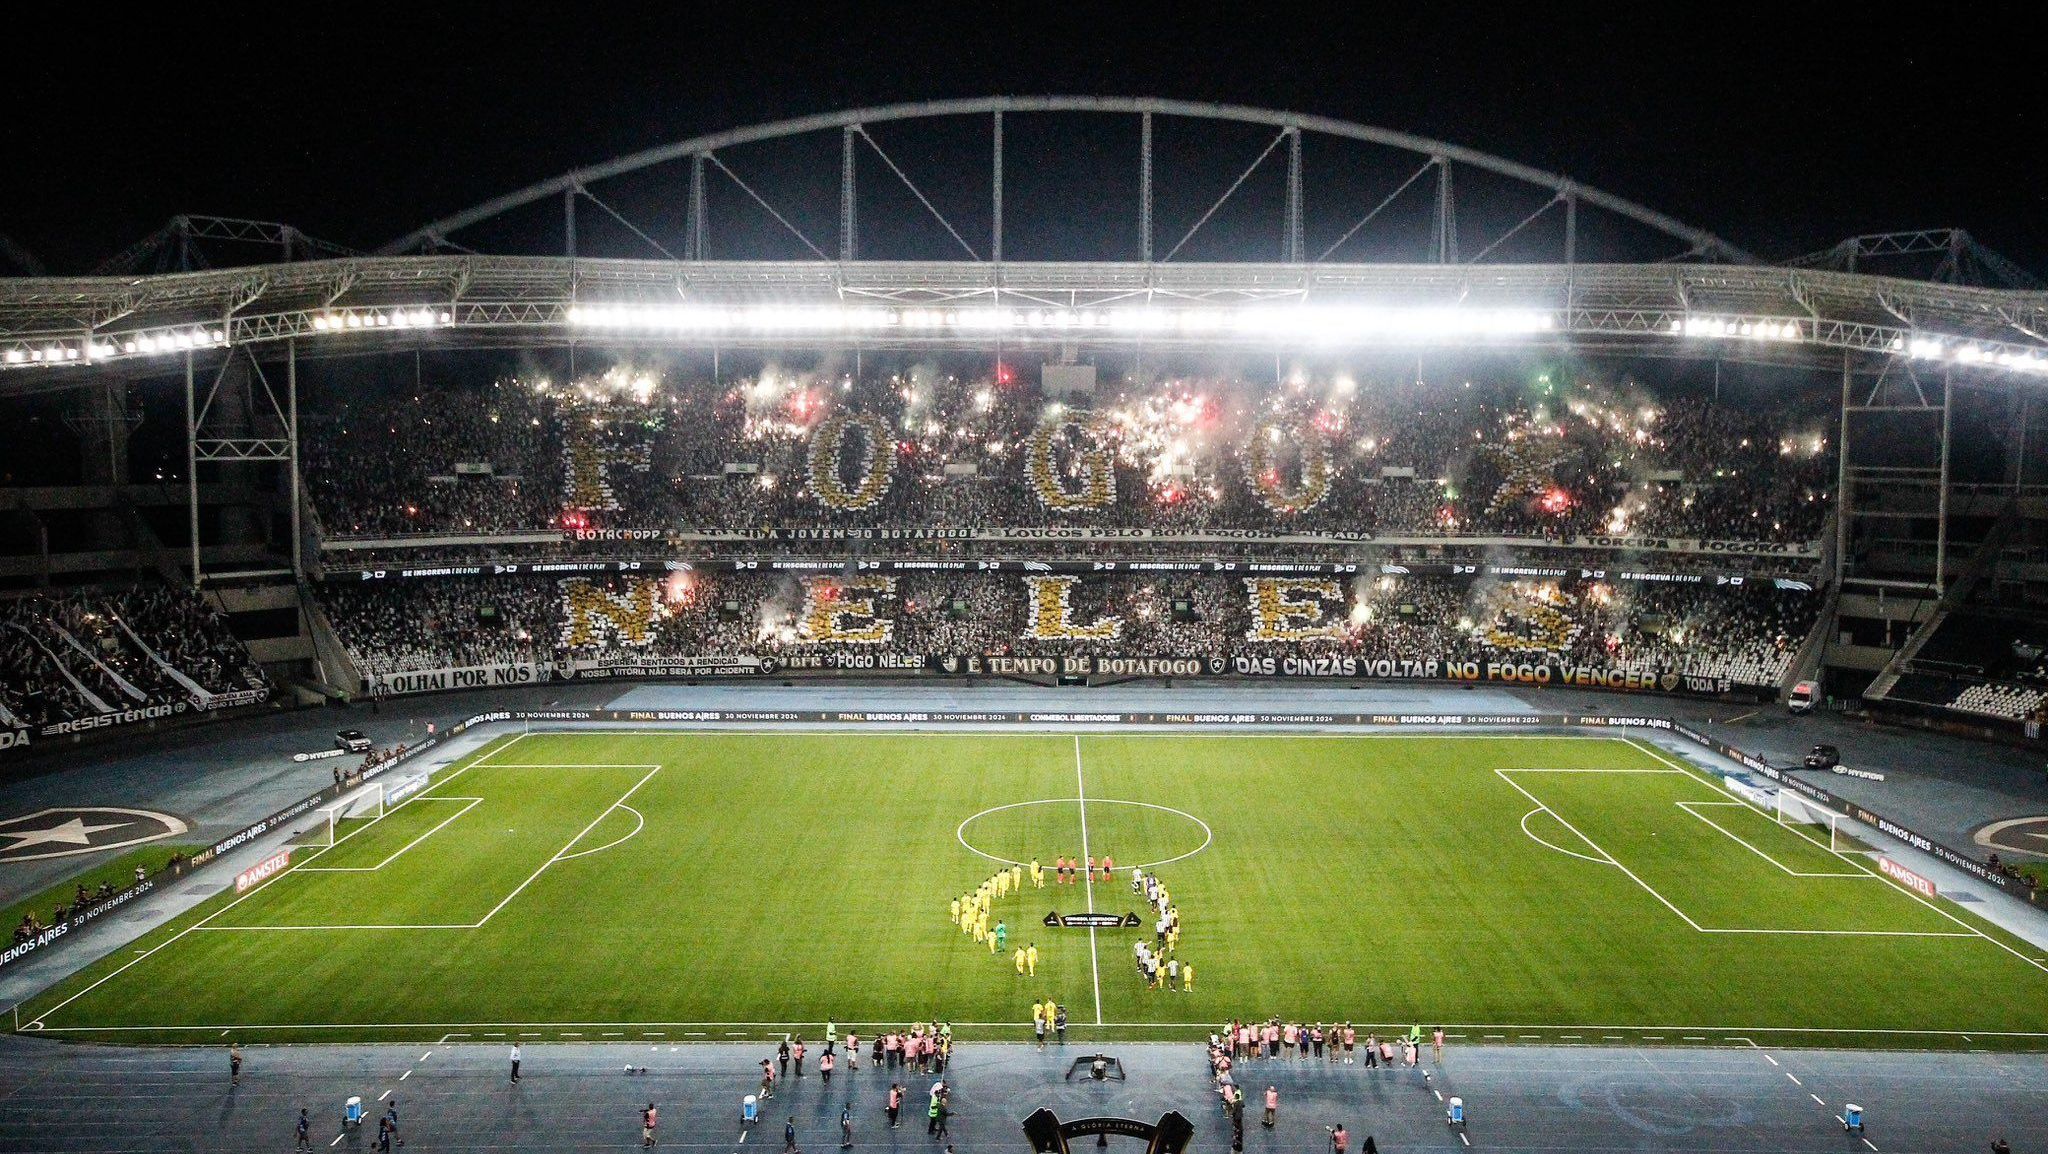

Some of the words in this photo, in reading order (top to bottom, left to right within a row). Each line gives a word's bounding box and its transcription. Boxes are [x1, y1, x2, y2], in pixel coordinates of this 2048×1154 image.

[576, 529, 661, 541] BOTACHOPP
[787, 529, 845, 539] JOVEM
[881, 529, 968, 539] BOTAFOGO
[1003, 529, 1083, 538] LOUCOS
[1090, 529, 1144, 538] PELO
[598, 658, 638, 667] ESPEREM
[640, 658, 685, 666] SENTADOS
[837, 655, 874, 668] FOGO
[879, 655, 926, 668] NELES!
[988, 657, 1058, 674] TEMPO
[1098, 658, 1201, 674] BOTAFOGO
[393, 673, 446, 692] OLHAI
[453, 670, 488, 687] POR
[494, 665, 530, 684] NÓS
[581, 669, 612, 678] NOSSA
[695, 668, 712, 676] POR
[714, 667, 755, 675] ACIDENTE
[1283, 658, 1357, 676] CINZAS
[1364, 660, 1439, 678] VOLTAR
[1447, 662, 1479, 680] NO
[1487, 663, 1551, 683] FOGO
[1560, 666, 1657, 689] VENCER
[1684, 676, 1714, 692] TODA
[631, 712, 656, 720] FINAL
[658, 712, 694, 720] BUENOS
[695, 712, 720, 722] AIRES
[838, 713, 864, 721] FINAL
[903, 714, 928, 723] AIRES
[1030, 714, 1070, 722] CONMEBOL
[1070, 714, 1121, 722] LIBERTADORES
[1166, 714, 1192, 722] FINAL
[1194, 714, 1229, 722] BUENOS
[1231, 714, 1256, 724] AIRES
[1437, 716, 1462, 725] AIRES
[1580, 717, 1606, 725] FINAL
[1608, 717, 1646, 726] BUENOS
[1646, 718, 1671, 729] AIRES
[309, 749, 345, 760] HYUNDAI
[1743, 757, 1764, 772] BUENOS
[362, 763, 385, 780] BUENOS
[1847, 769, 1885, 781] HYUNDAI
[191, 848, 215, 867] FINAL
[216, 832, 247, 855] BUENOS
[247, 822, 267, 840] AIRES
[278, 803, 310, 822] NOVIEMBRE
[309, 796, 322, 807] 2024
[1858, 810, 1878, 827] FINAL
[1878, 820, 1909, 842] BUENOS
[1909, 834, 1931, 852] AIRES
[1935, 847, 1943, 856] 30
[1945, 851, 1986, 878] NOVIEMBRE
[1987, 872, 2006, 886] 2024
[249, 852, 289, 886] AMSTEL
[1890, 863, 1935, 897] AMSTEL
[37, 922, 68, 946] AIRES
[74, 914, 85, 927] 30
[86, 890, 134, 920] NOVIEMBRE
[135, 881, 154, 895] 2024
[1115, 1123, 1145, 1132] ETERNA
